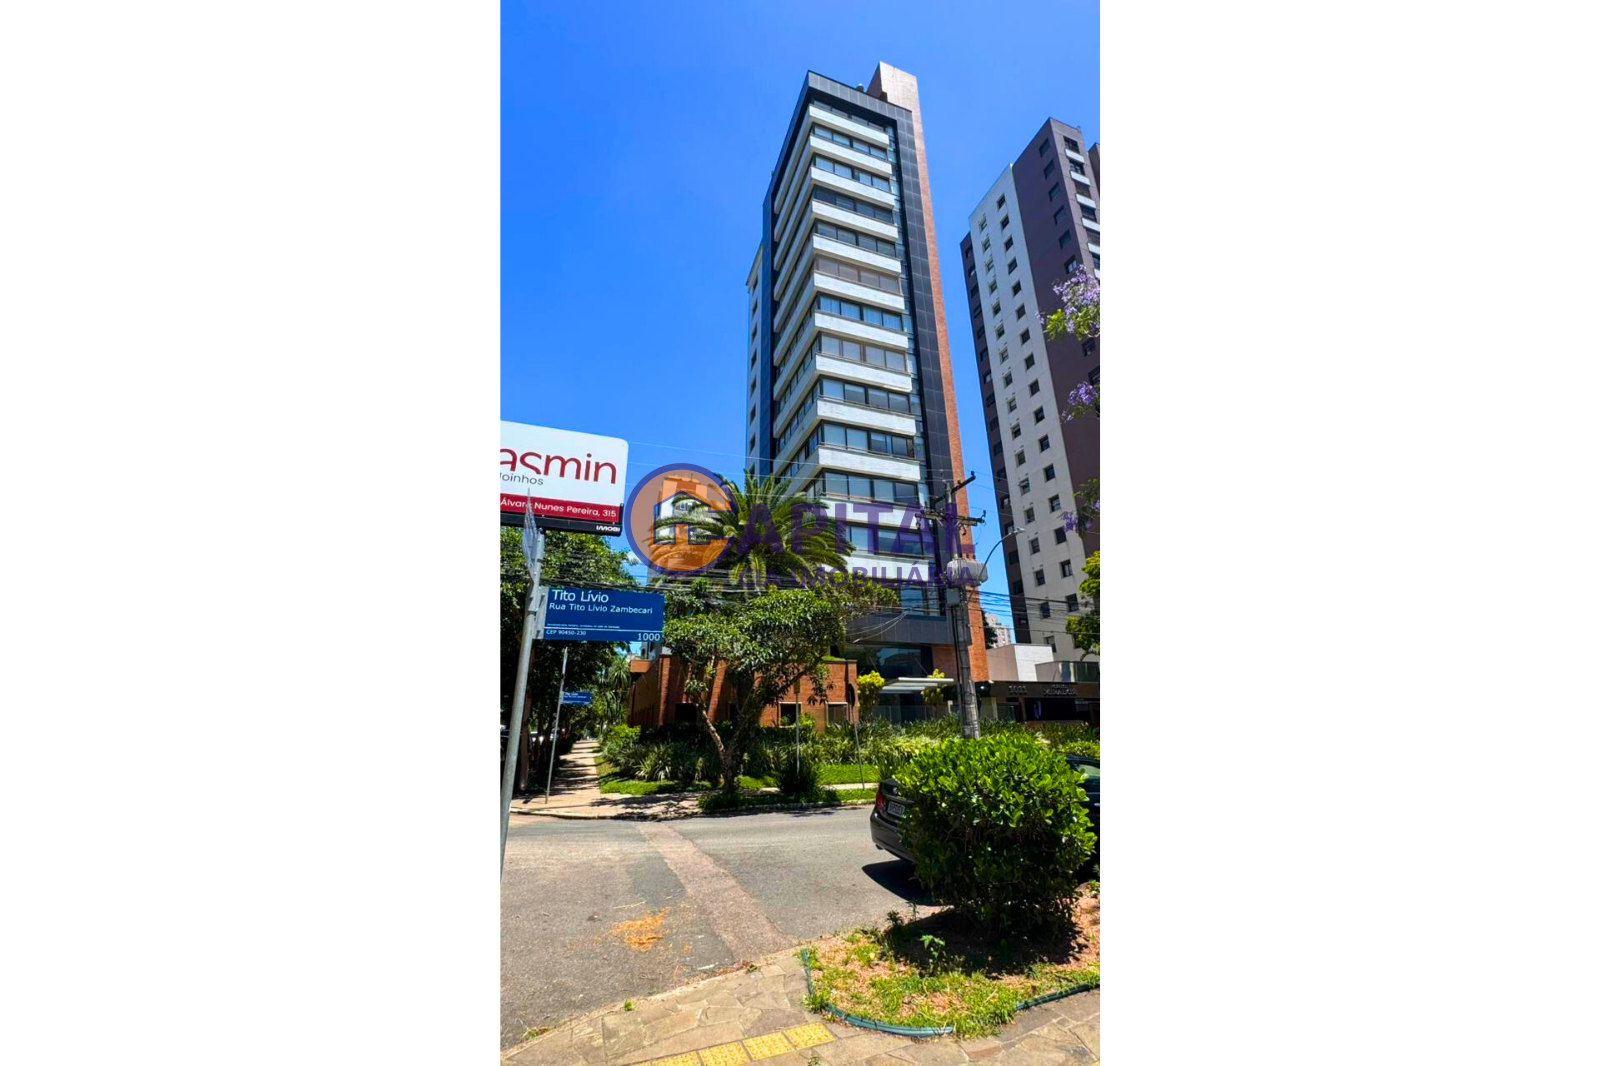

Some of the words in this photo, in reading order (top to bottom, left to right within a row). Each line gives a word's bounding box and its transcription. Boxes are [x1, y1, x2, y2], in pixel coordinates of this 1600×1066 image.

[501, 497, 529, 509] Álvar
[534, 503, 564, 512] Nunes
[566, 506, 601, 517] Pereira,
[603, 509, 617, 518] 315
[551, 589, 576, 601] Tito
[580, 590, 609, 603] Lívio
[549, 602, 566, 610] Rua
[569, 603, 586, 611] Tito
[588, 604, 608, 612] Lívio
[610, 605, 653, 614] Zambecari
[637, 632, 661, 641] 1000
